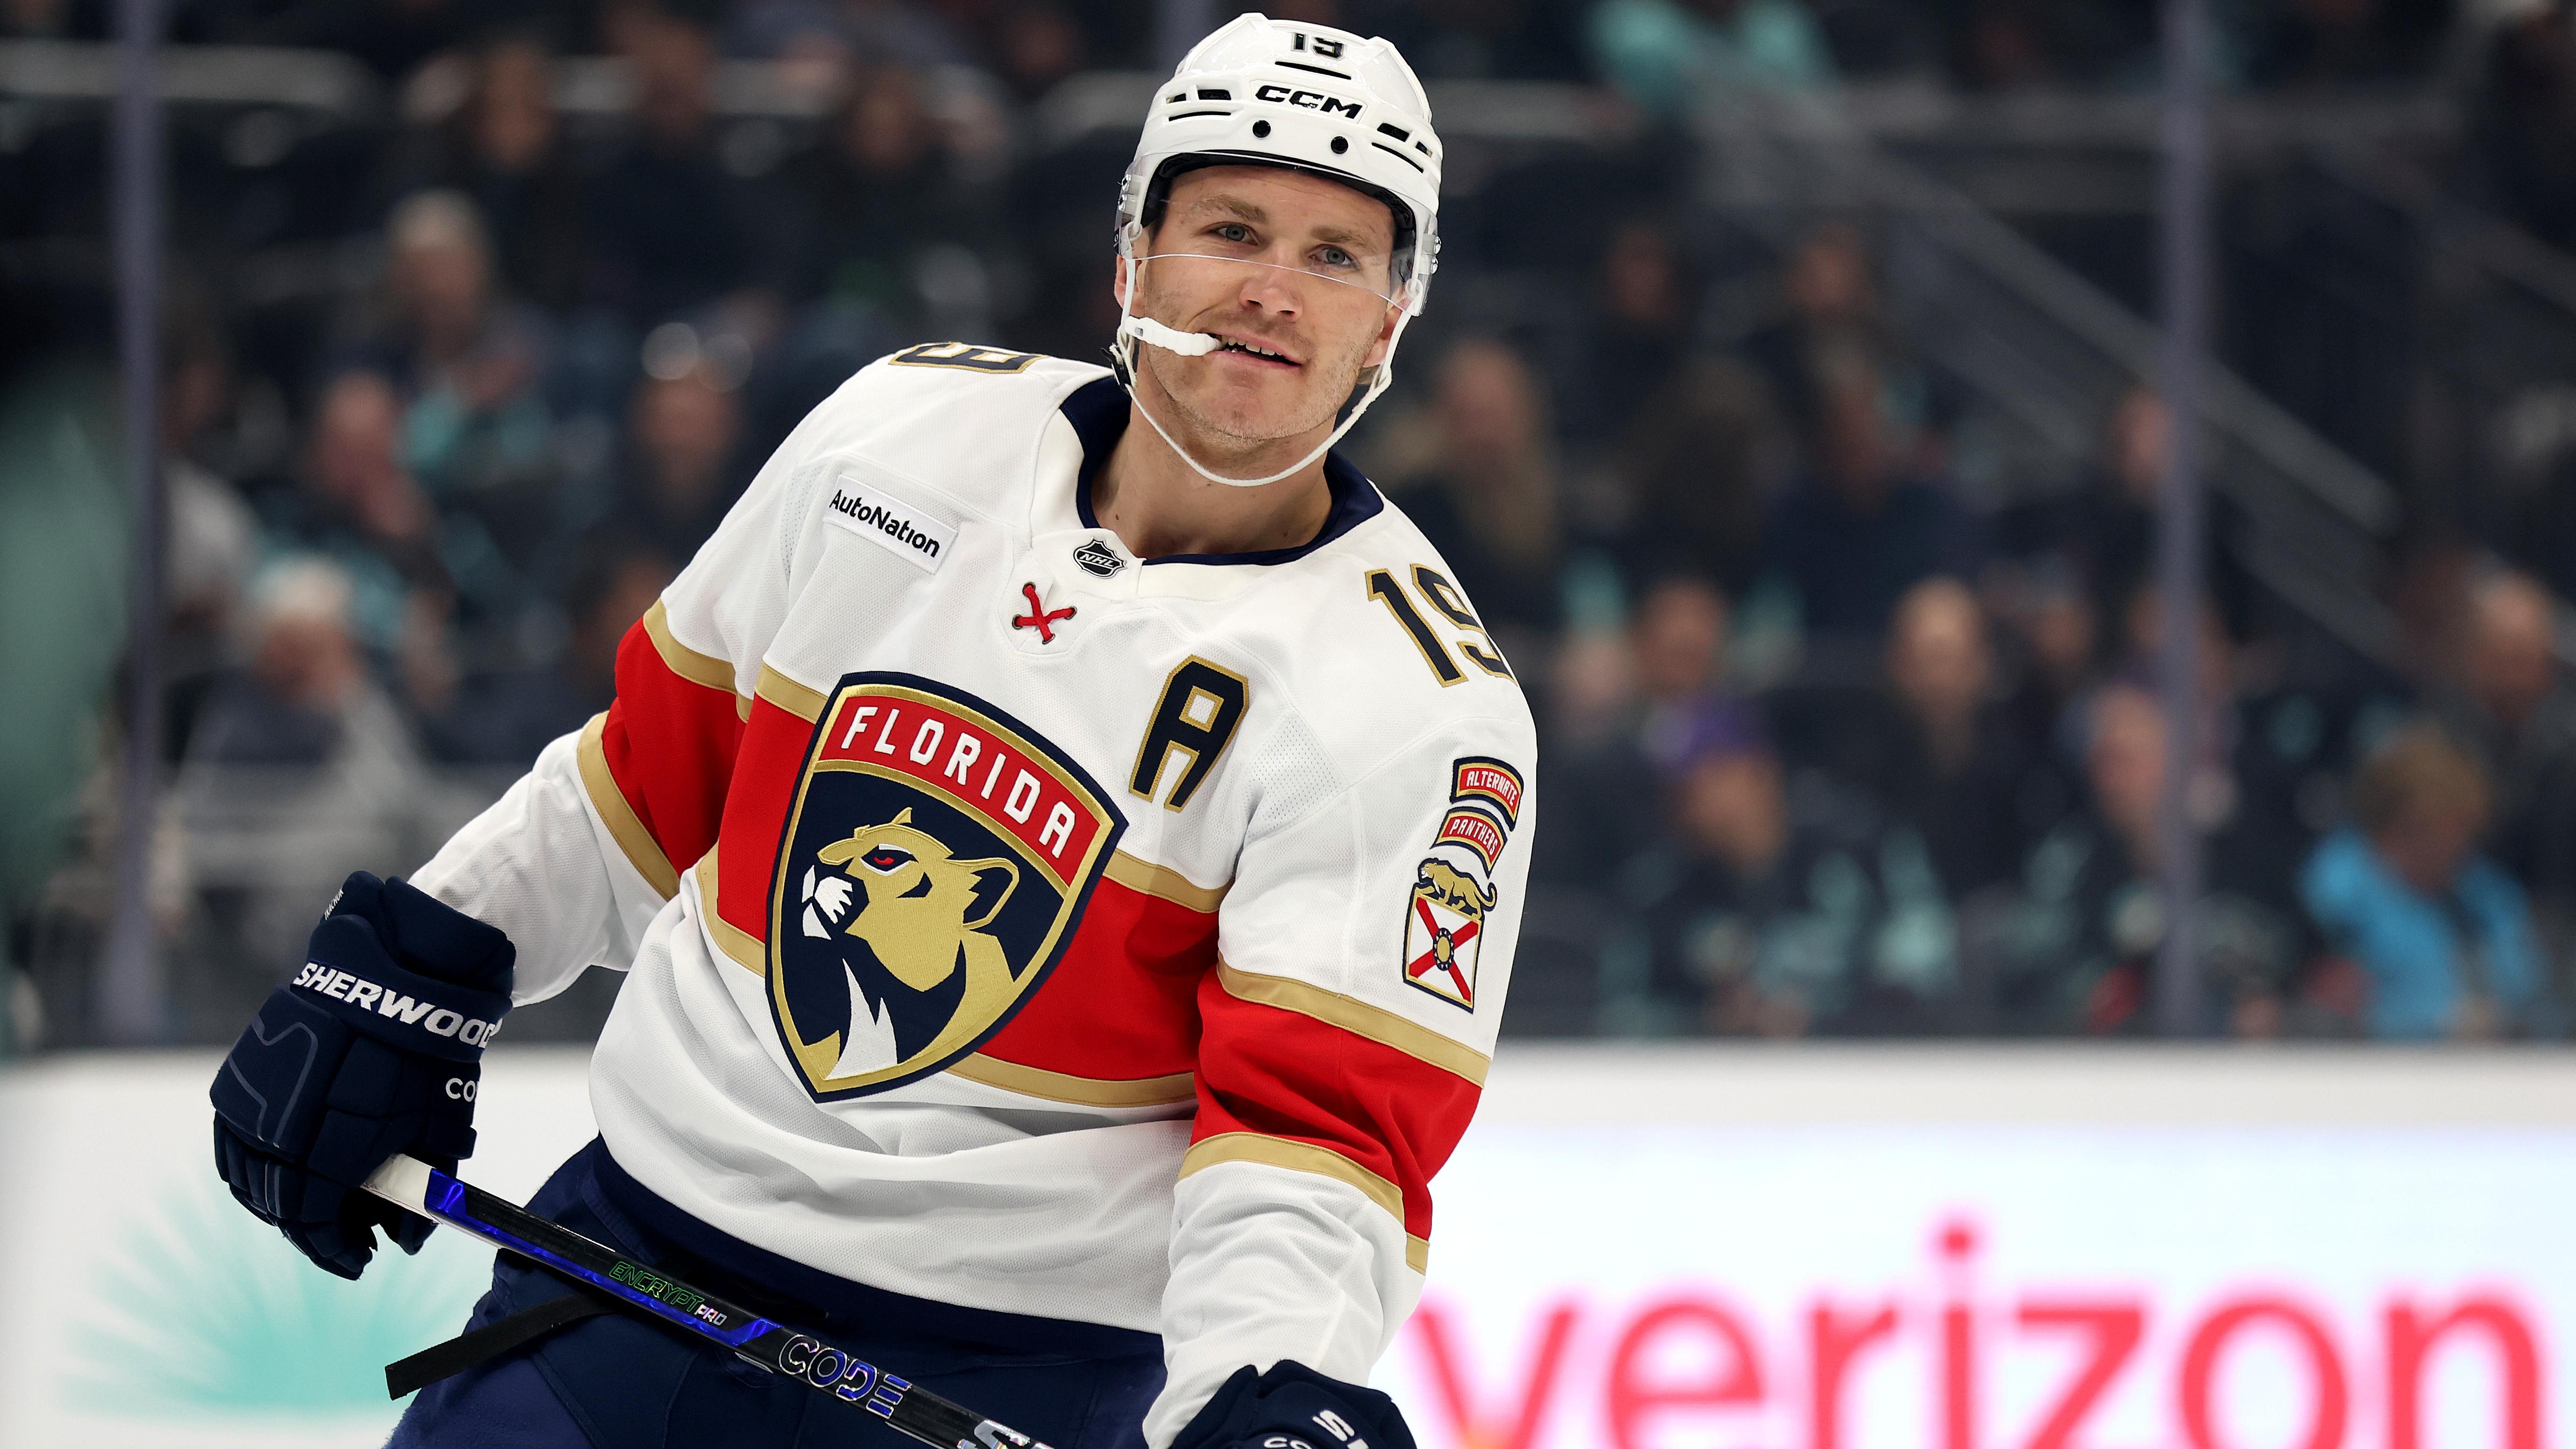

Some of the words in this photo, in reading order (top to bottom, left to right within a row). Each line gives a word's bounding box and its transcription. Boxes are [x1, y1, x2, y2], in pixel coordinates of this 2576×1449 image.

[1255, 85, 1363, 119] CCM
[829, 489, 940, 558] AutoNation
[1079, 553, 1114, 568] NHL
[1365, 563, 1518, 688] 19
[1128, 654, 1249, 813] A
[840, 706, 1076, 858] FLORIDA
[1466, 771, 1517, 807] ALTERNATE
[1449, 818, 1498, 856] PANTHERS
[292, 962, 504, 1049] SHERWOOD
[445, 1077, 480, 1102] CO
[609, 1261, 706, 1312] ENCRYPT
[694, 1304, 728, 1326] PRO
[1408, 1214, 2547, 1449] verizon
[779, 1334, 912, 1419] CODE
